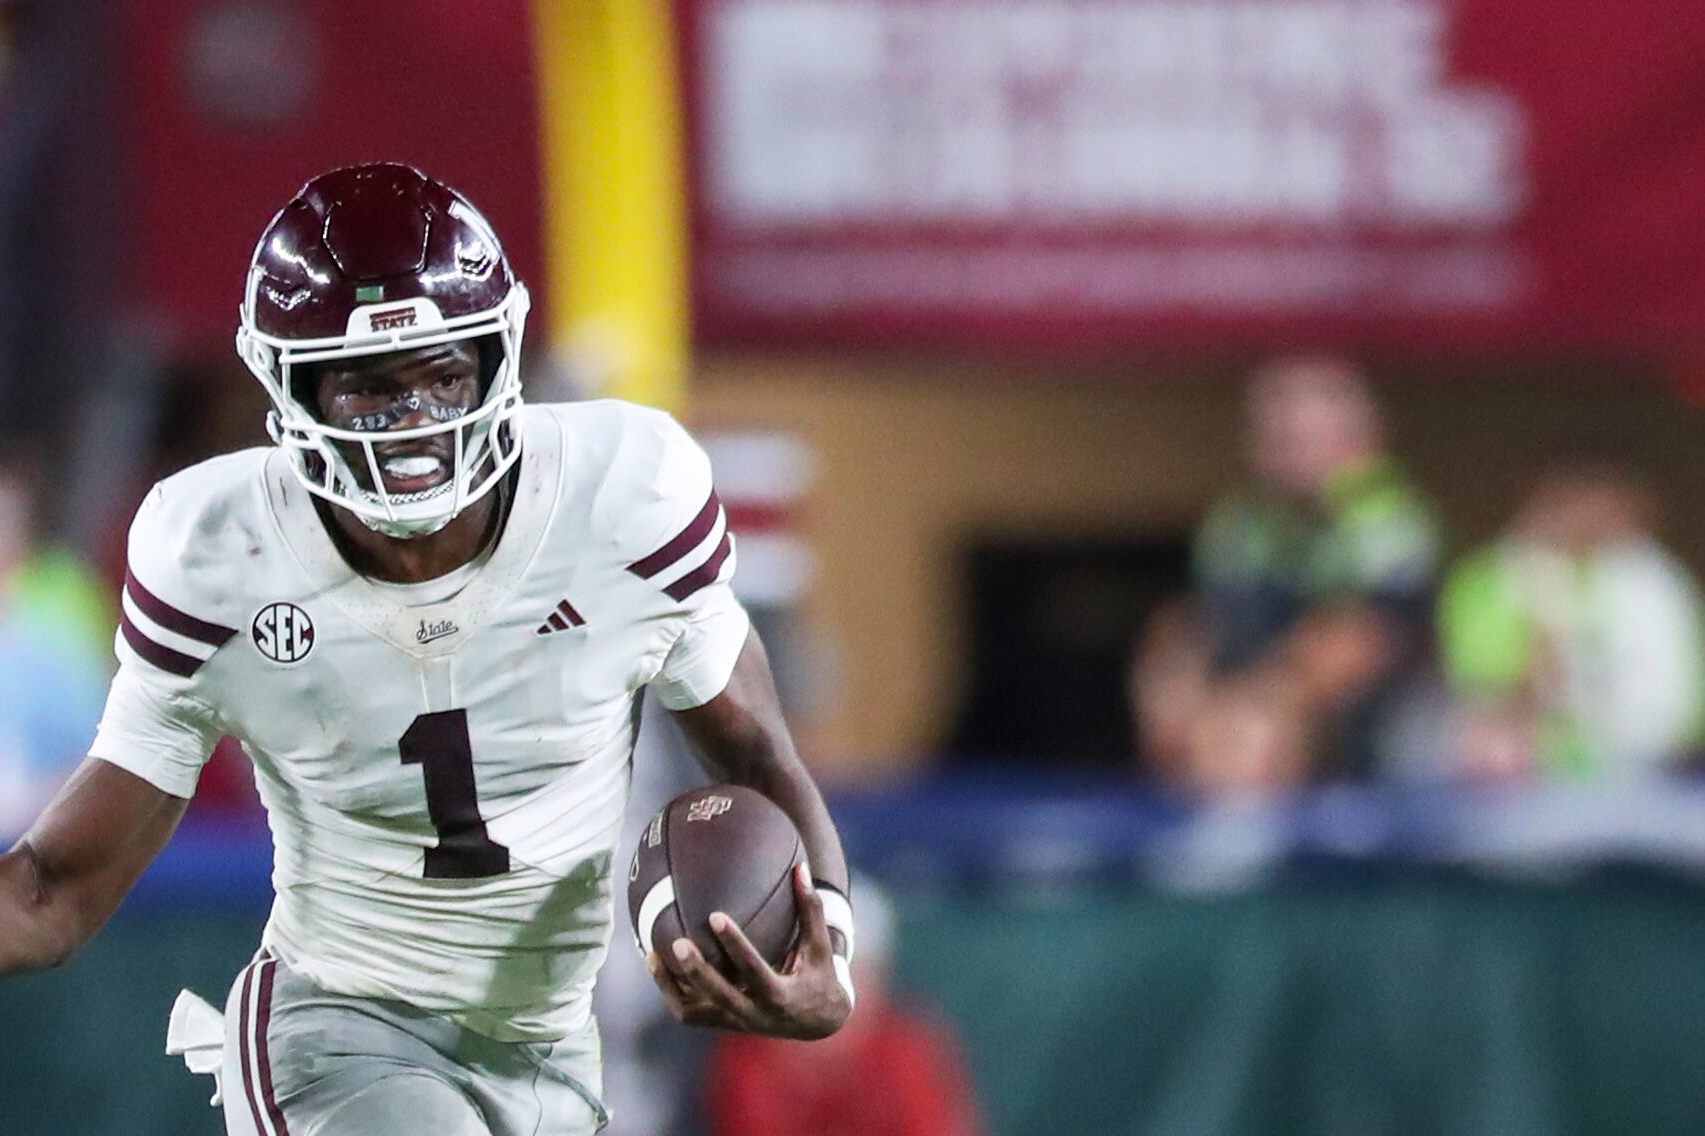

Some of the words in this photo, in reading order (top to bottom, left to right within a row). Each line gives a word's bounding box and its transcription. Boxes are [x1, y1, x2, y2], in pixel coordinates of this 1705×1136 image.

[252, 603, 315, 662] SEC
[415, 618, 459, 644] State
[398, 708, 511, 879] 1
